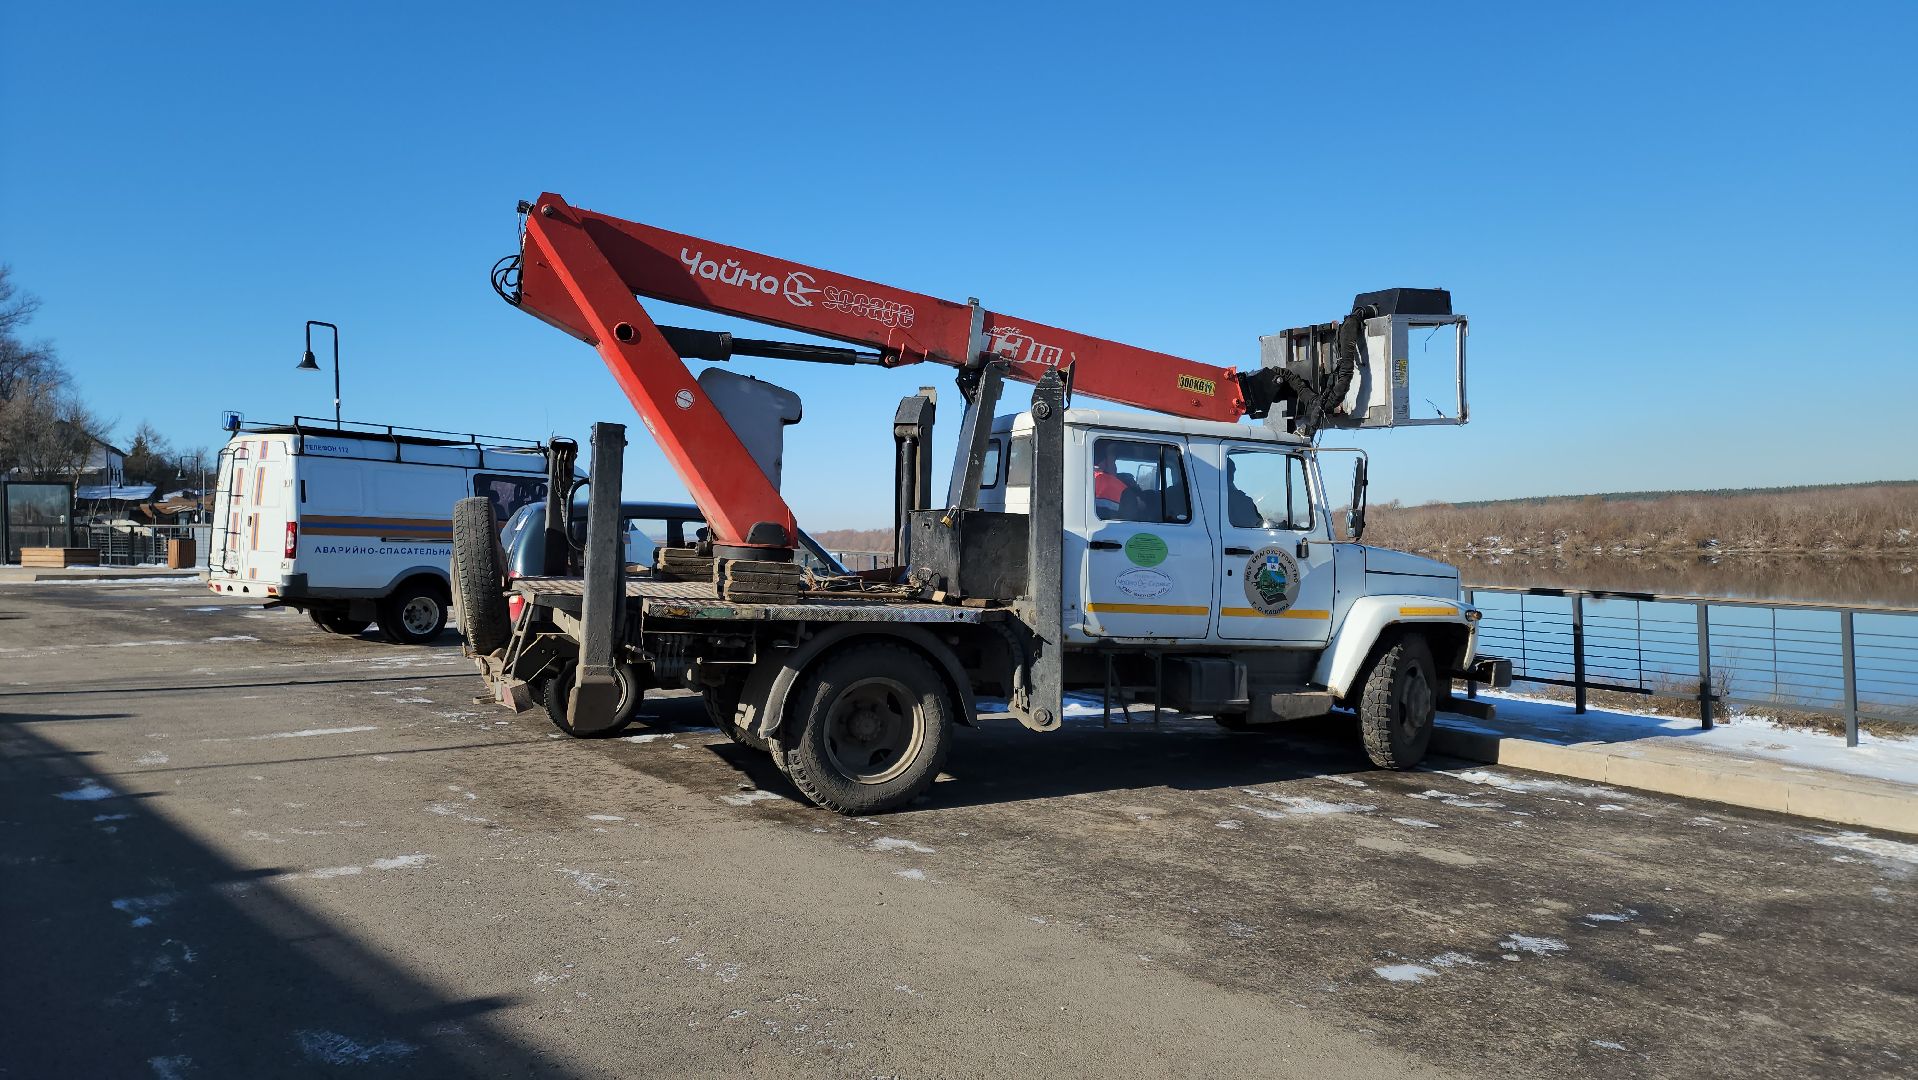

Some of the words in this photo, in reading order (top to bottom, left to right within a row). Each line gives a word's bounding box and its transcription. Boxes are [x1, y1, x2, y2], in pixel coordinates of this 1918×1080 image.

[680, 247, 779, 296] Чайка
[338, 445, 349, 454] 112
[314, 545, 452, 557] АВАРИЙНО-СПАСАТЕЛЬНА
